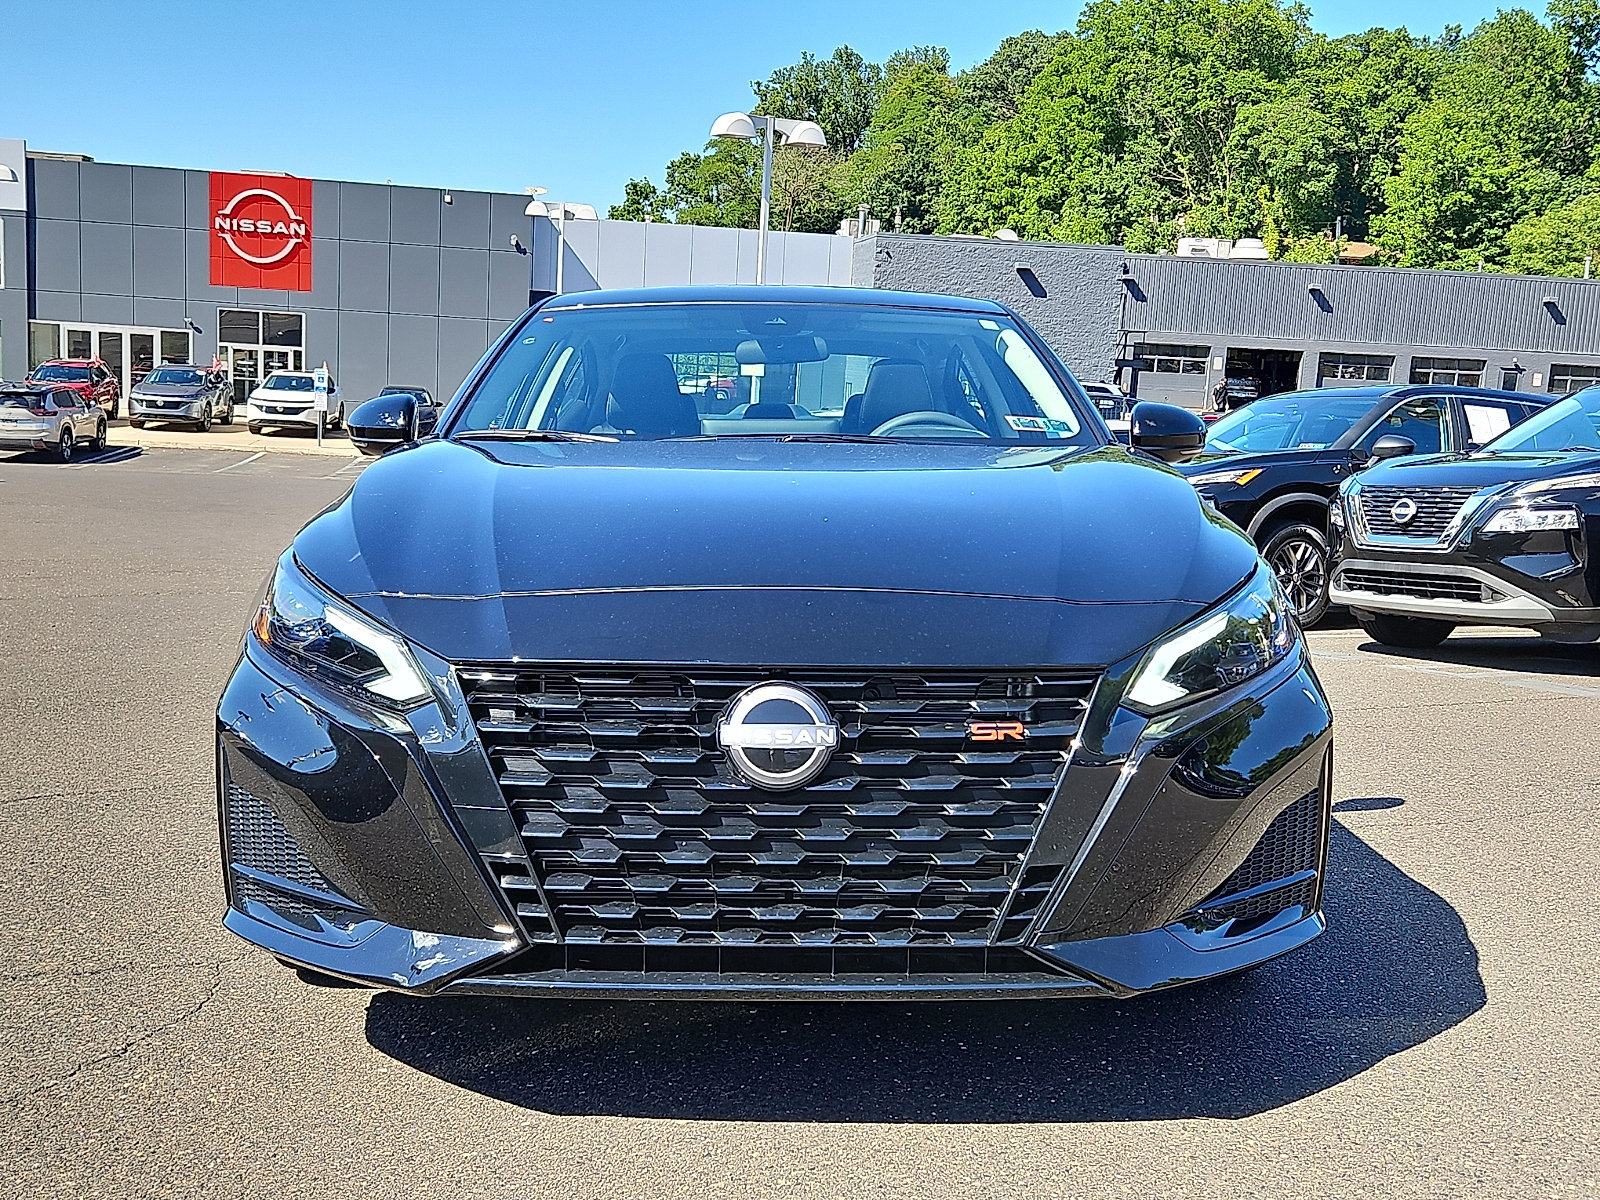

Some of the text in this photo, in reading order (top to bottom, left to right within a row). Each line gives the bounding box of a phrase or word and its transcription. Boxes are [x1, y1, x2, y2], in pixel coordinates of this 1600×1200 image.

[214, 216, 306, 236] NISSAN
[722, 727, 835, 745] ISSAN
[970, 722, 1024, 741] SR
